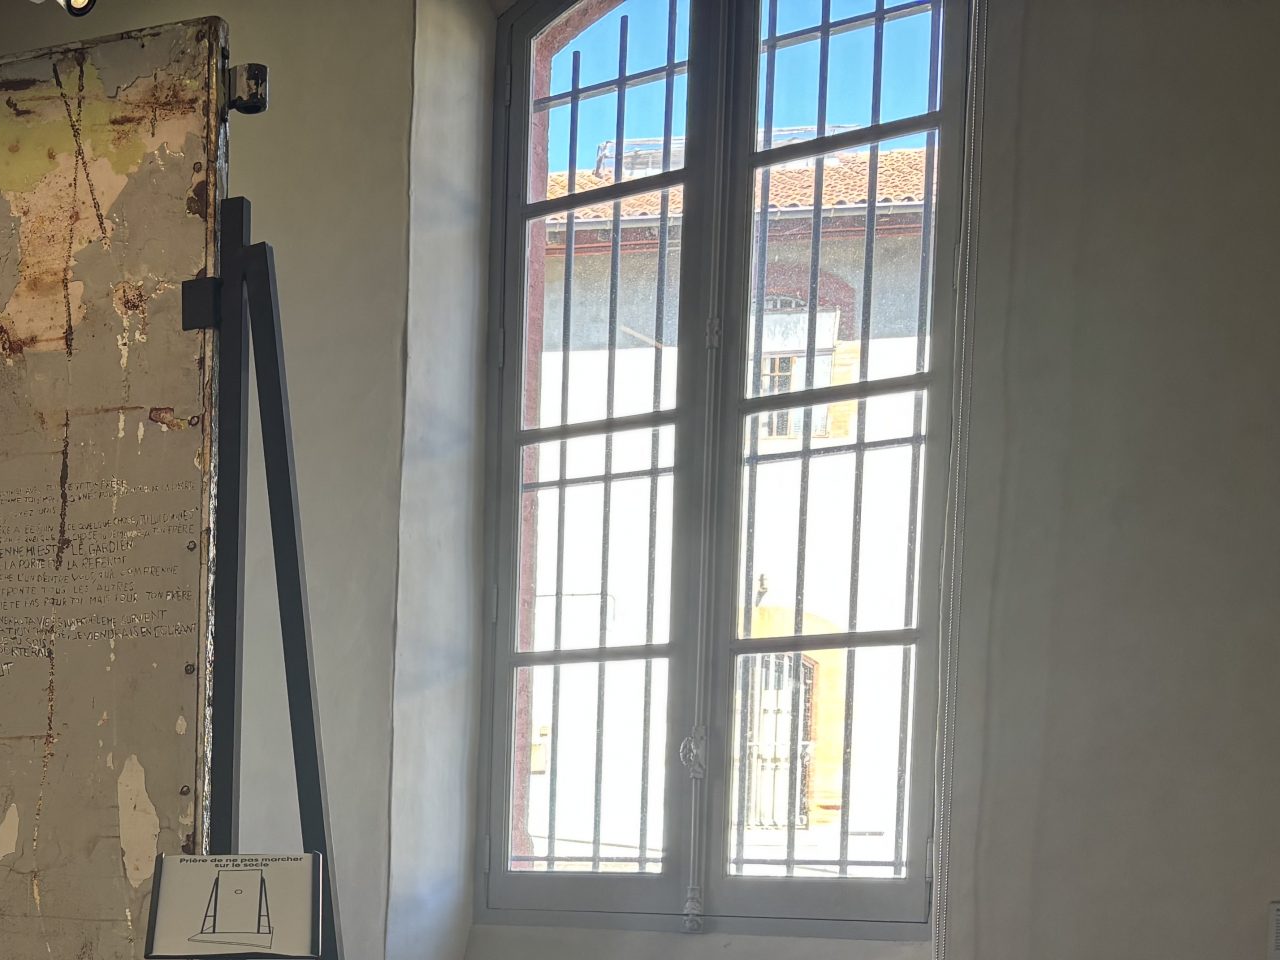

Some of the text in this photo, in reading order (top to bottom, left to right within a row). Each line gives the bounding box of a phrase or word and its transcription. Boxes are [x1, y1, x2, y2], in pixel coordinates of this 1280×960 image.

[36, 543, 58, 557] EST
[70, 542, 84, 556] LE
[87, 539, 134, 557] GARDIEN
[3, 559, 17, 571] LA
[18, 557, 46, 570] PORTE
[66, 559, 79, 571] LA
[96, 580, 135, 593] AUTRES
[43, 596, 68, 608] POUR
[69, 595, 84, 606] TOI
[144, 590, 163, 600] TON
